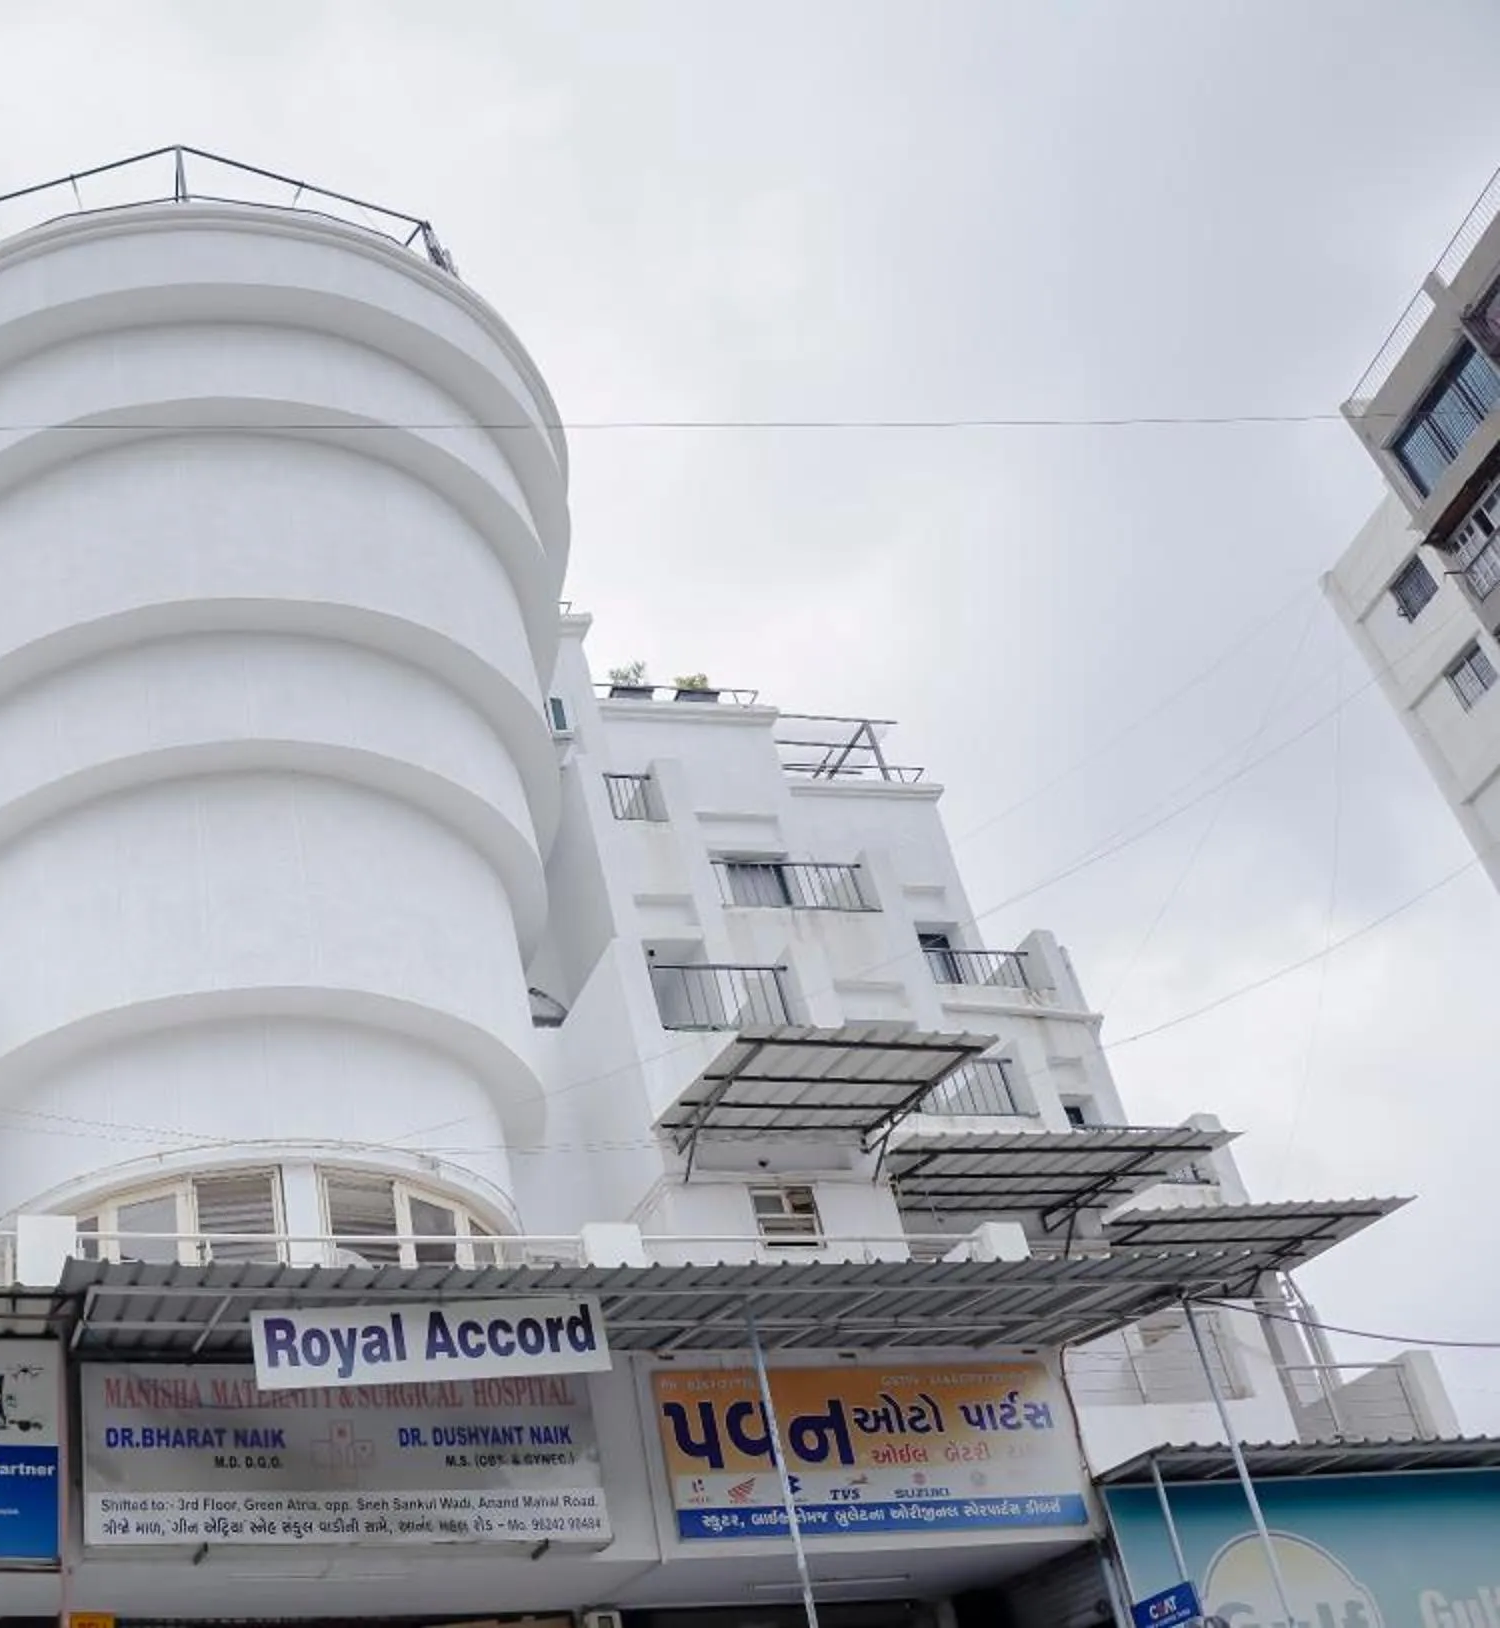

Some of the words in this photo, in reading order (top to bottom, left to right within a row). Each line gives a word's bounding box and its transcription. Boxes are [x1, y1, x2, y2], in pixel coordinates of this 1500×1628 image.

[263, 1312, 407, 1379] Royal
[426, 1303, 597, 1361] Accord
[104, 1377, 202, 1410] MANISHA
[354, 1381, 463, 1409] SURGICAL
[472, 1376, 576, 1409] HOSPITAL
[852, 1392, 945, 1434] ઓટો
[105, 1427, 227, 1449] DR.BHARAT
[233, 1429, 286, 1449] NAIK
[399, 1427, 428, 1447] DR.
[432, 1425, 524, 1447] DUSHYANT
[530, 1424, 573, 1445] NAIK
[662, 1397, 855, 1469] પવન
[214, 1455, 241, 1469] M.D.
[445, 1455, 470, 1468] M.S.
[101, 1499, 149, 1513] Shifted
[179, 1498, 199, 1511] 3rd
[244, 1498, 283, 1511] Green
[357, 1497, 390, 1511] Sneh
[393, 1497, 438, 1511] Sankul
[479, 1496, 519, 1509] Anand
[828, 1487, 862, 1501] TVS
